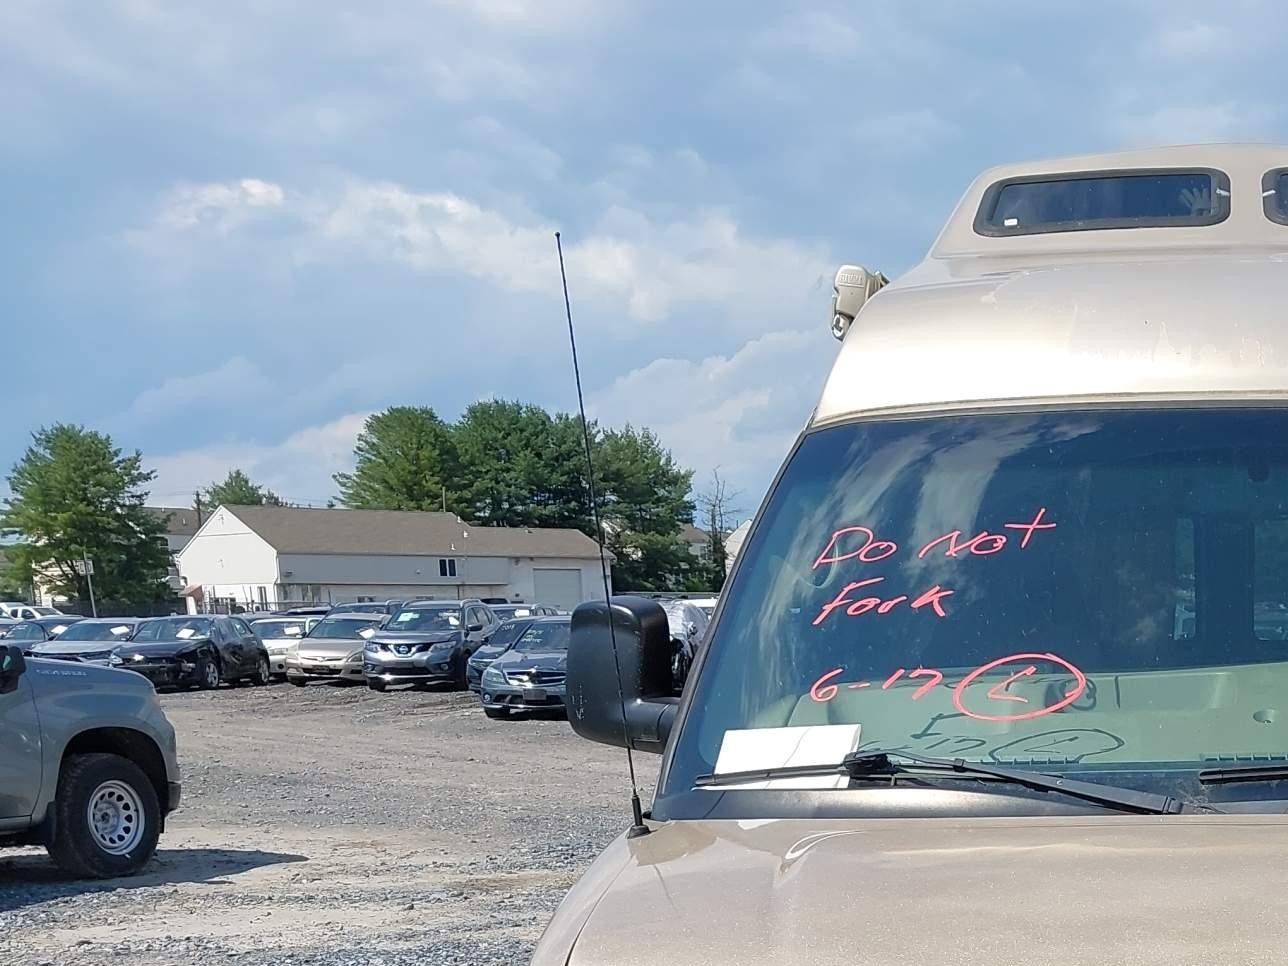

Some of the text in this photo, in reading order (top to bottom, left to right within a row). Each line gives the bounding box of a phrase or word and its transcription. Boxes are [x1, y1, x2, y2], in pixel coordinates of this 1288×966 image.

[812, 526, 897, 570] Do
[812, 576, 955, 625] Fork
[809, 667, 944, 702] 6-17
